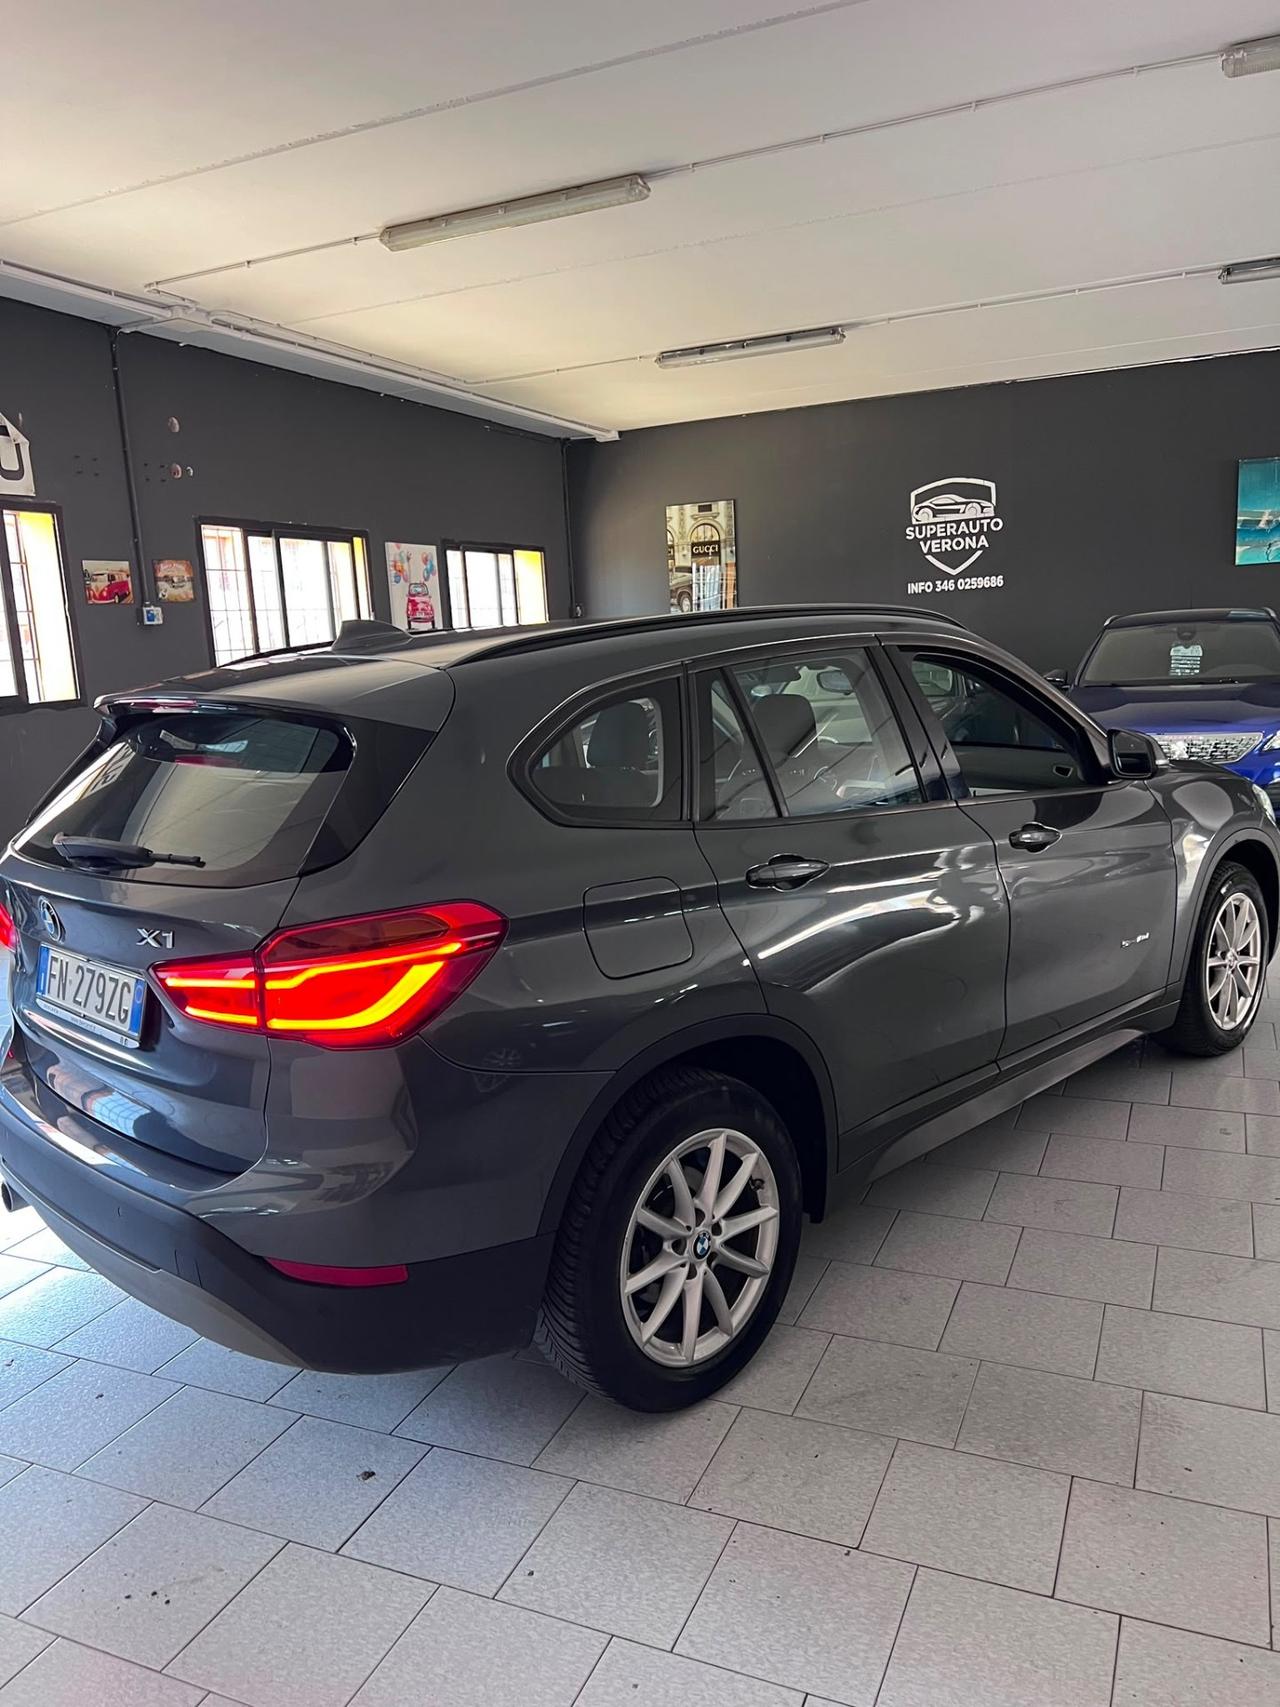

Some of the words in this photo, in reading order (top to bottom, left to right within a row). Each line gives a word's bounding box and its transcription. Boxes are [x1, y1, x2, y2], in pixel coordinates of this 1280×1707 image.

[905, 518, 1004, 540] SUPERAUTO
[692, 545, 719, 554] GUCCI
[919, 535, 989, 554] VERONA
[907, 581, 933, 594] INFO
[935, 579, 955, 592] 346
[957, 575, 1004, 590] 0259686
[136, 928, 175, 949] X1
[48, 955, 69, 1001] FN
[72, 965, 131, 1024] 279ZG
